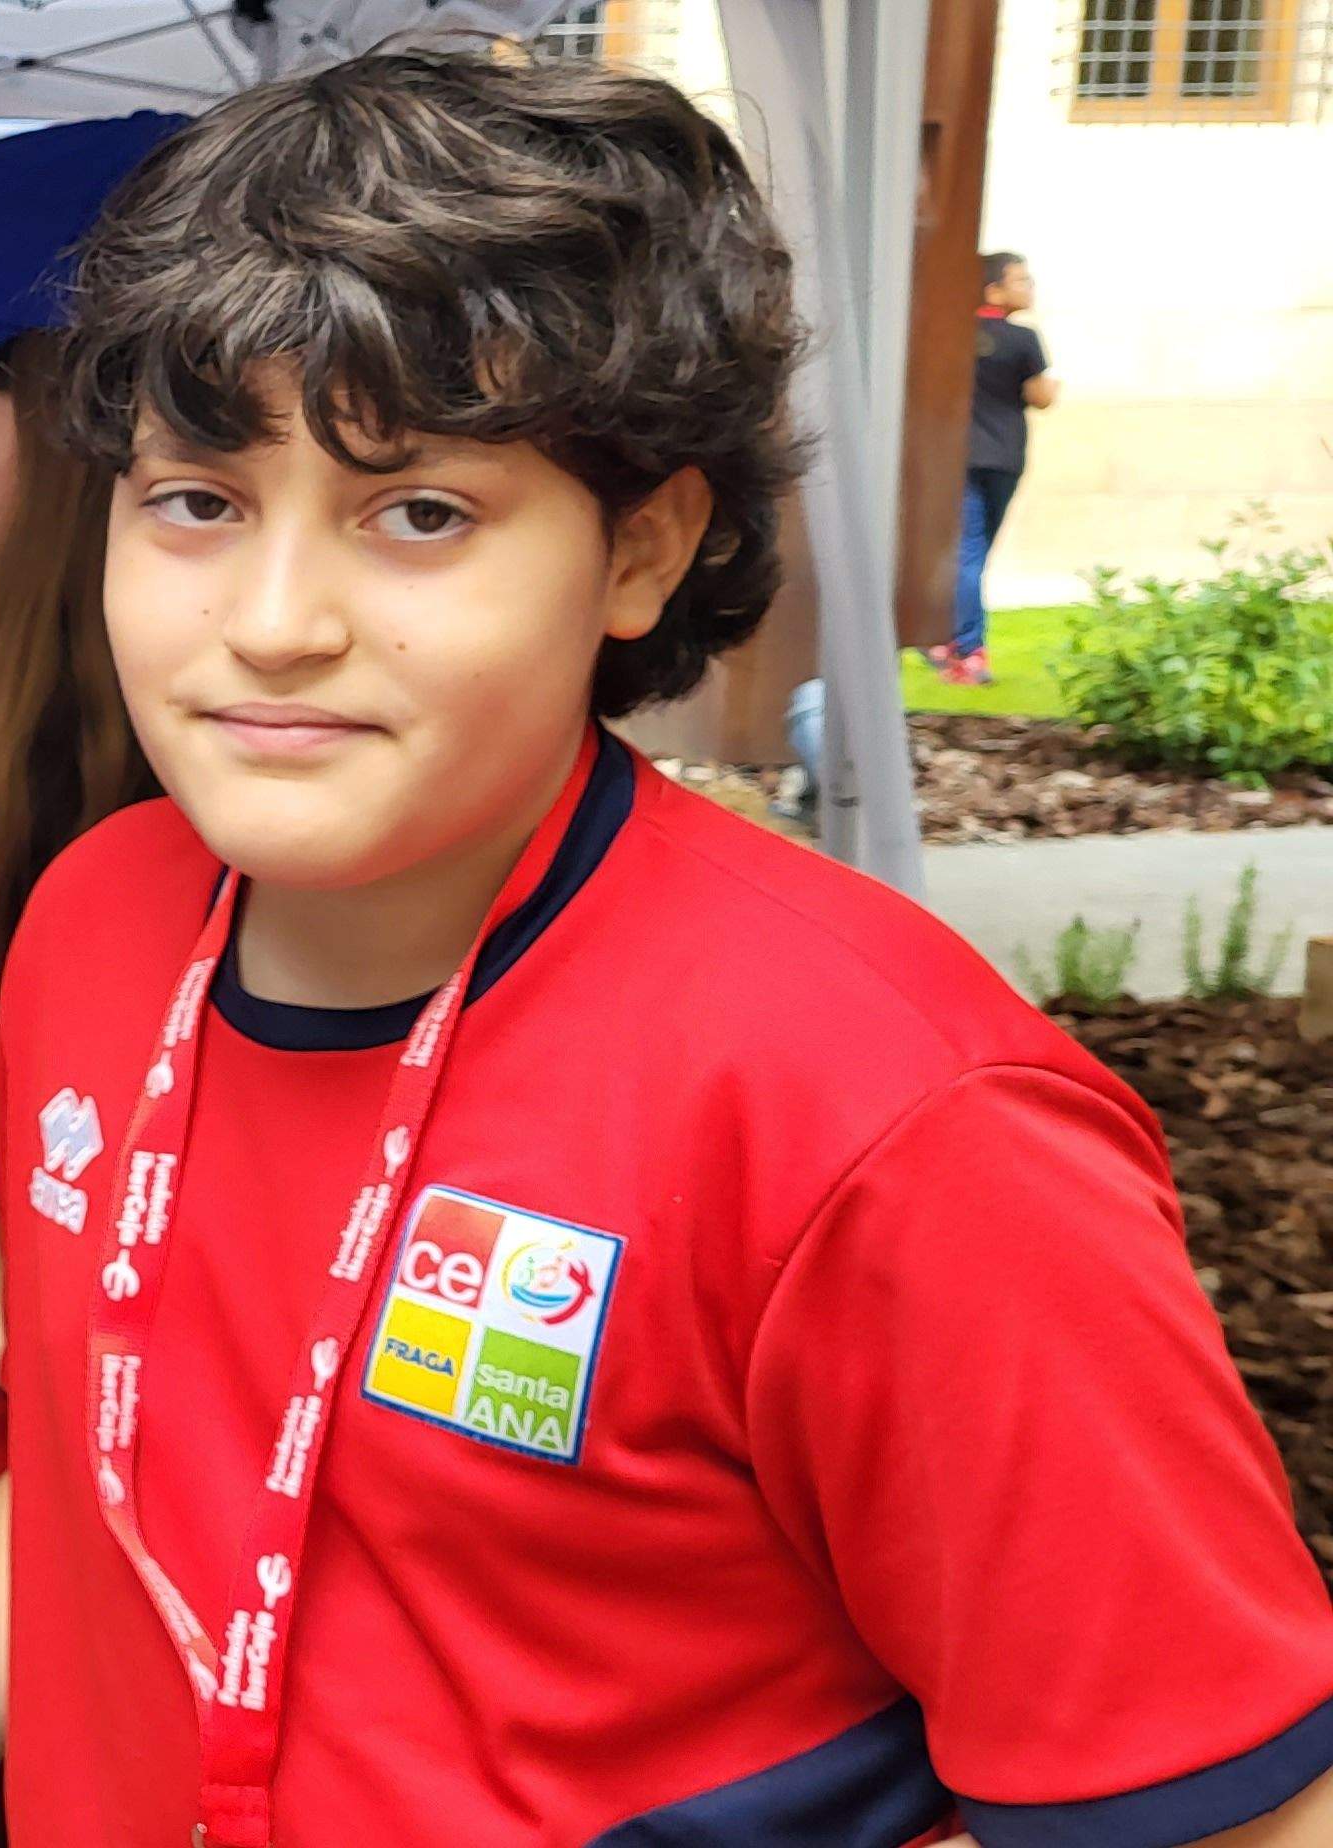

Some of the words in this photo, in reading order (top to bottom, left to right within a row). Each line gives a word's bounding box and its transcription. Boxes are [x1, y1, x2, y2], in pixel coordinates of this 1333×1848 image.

[399, 1239, 484, 1305] ce
[384, 1337, 455, 1377] FRAGA
[475, 1363, 571, 1412] santa
[462, 1396, 566, 1451] ANA
[216, 1610, 252, 1707] Fundación
